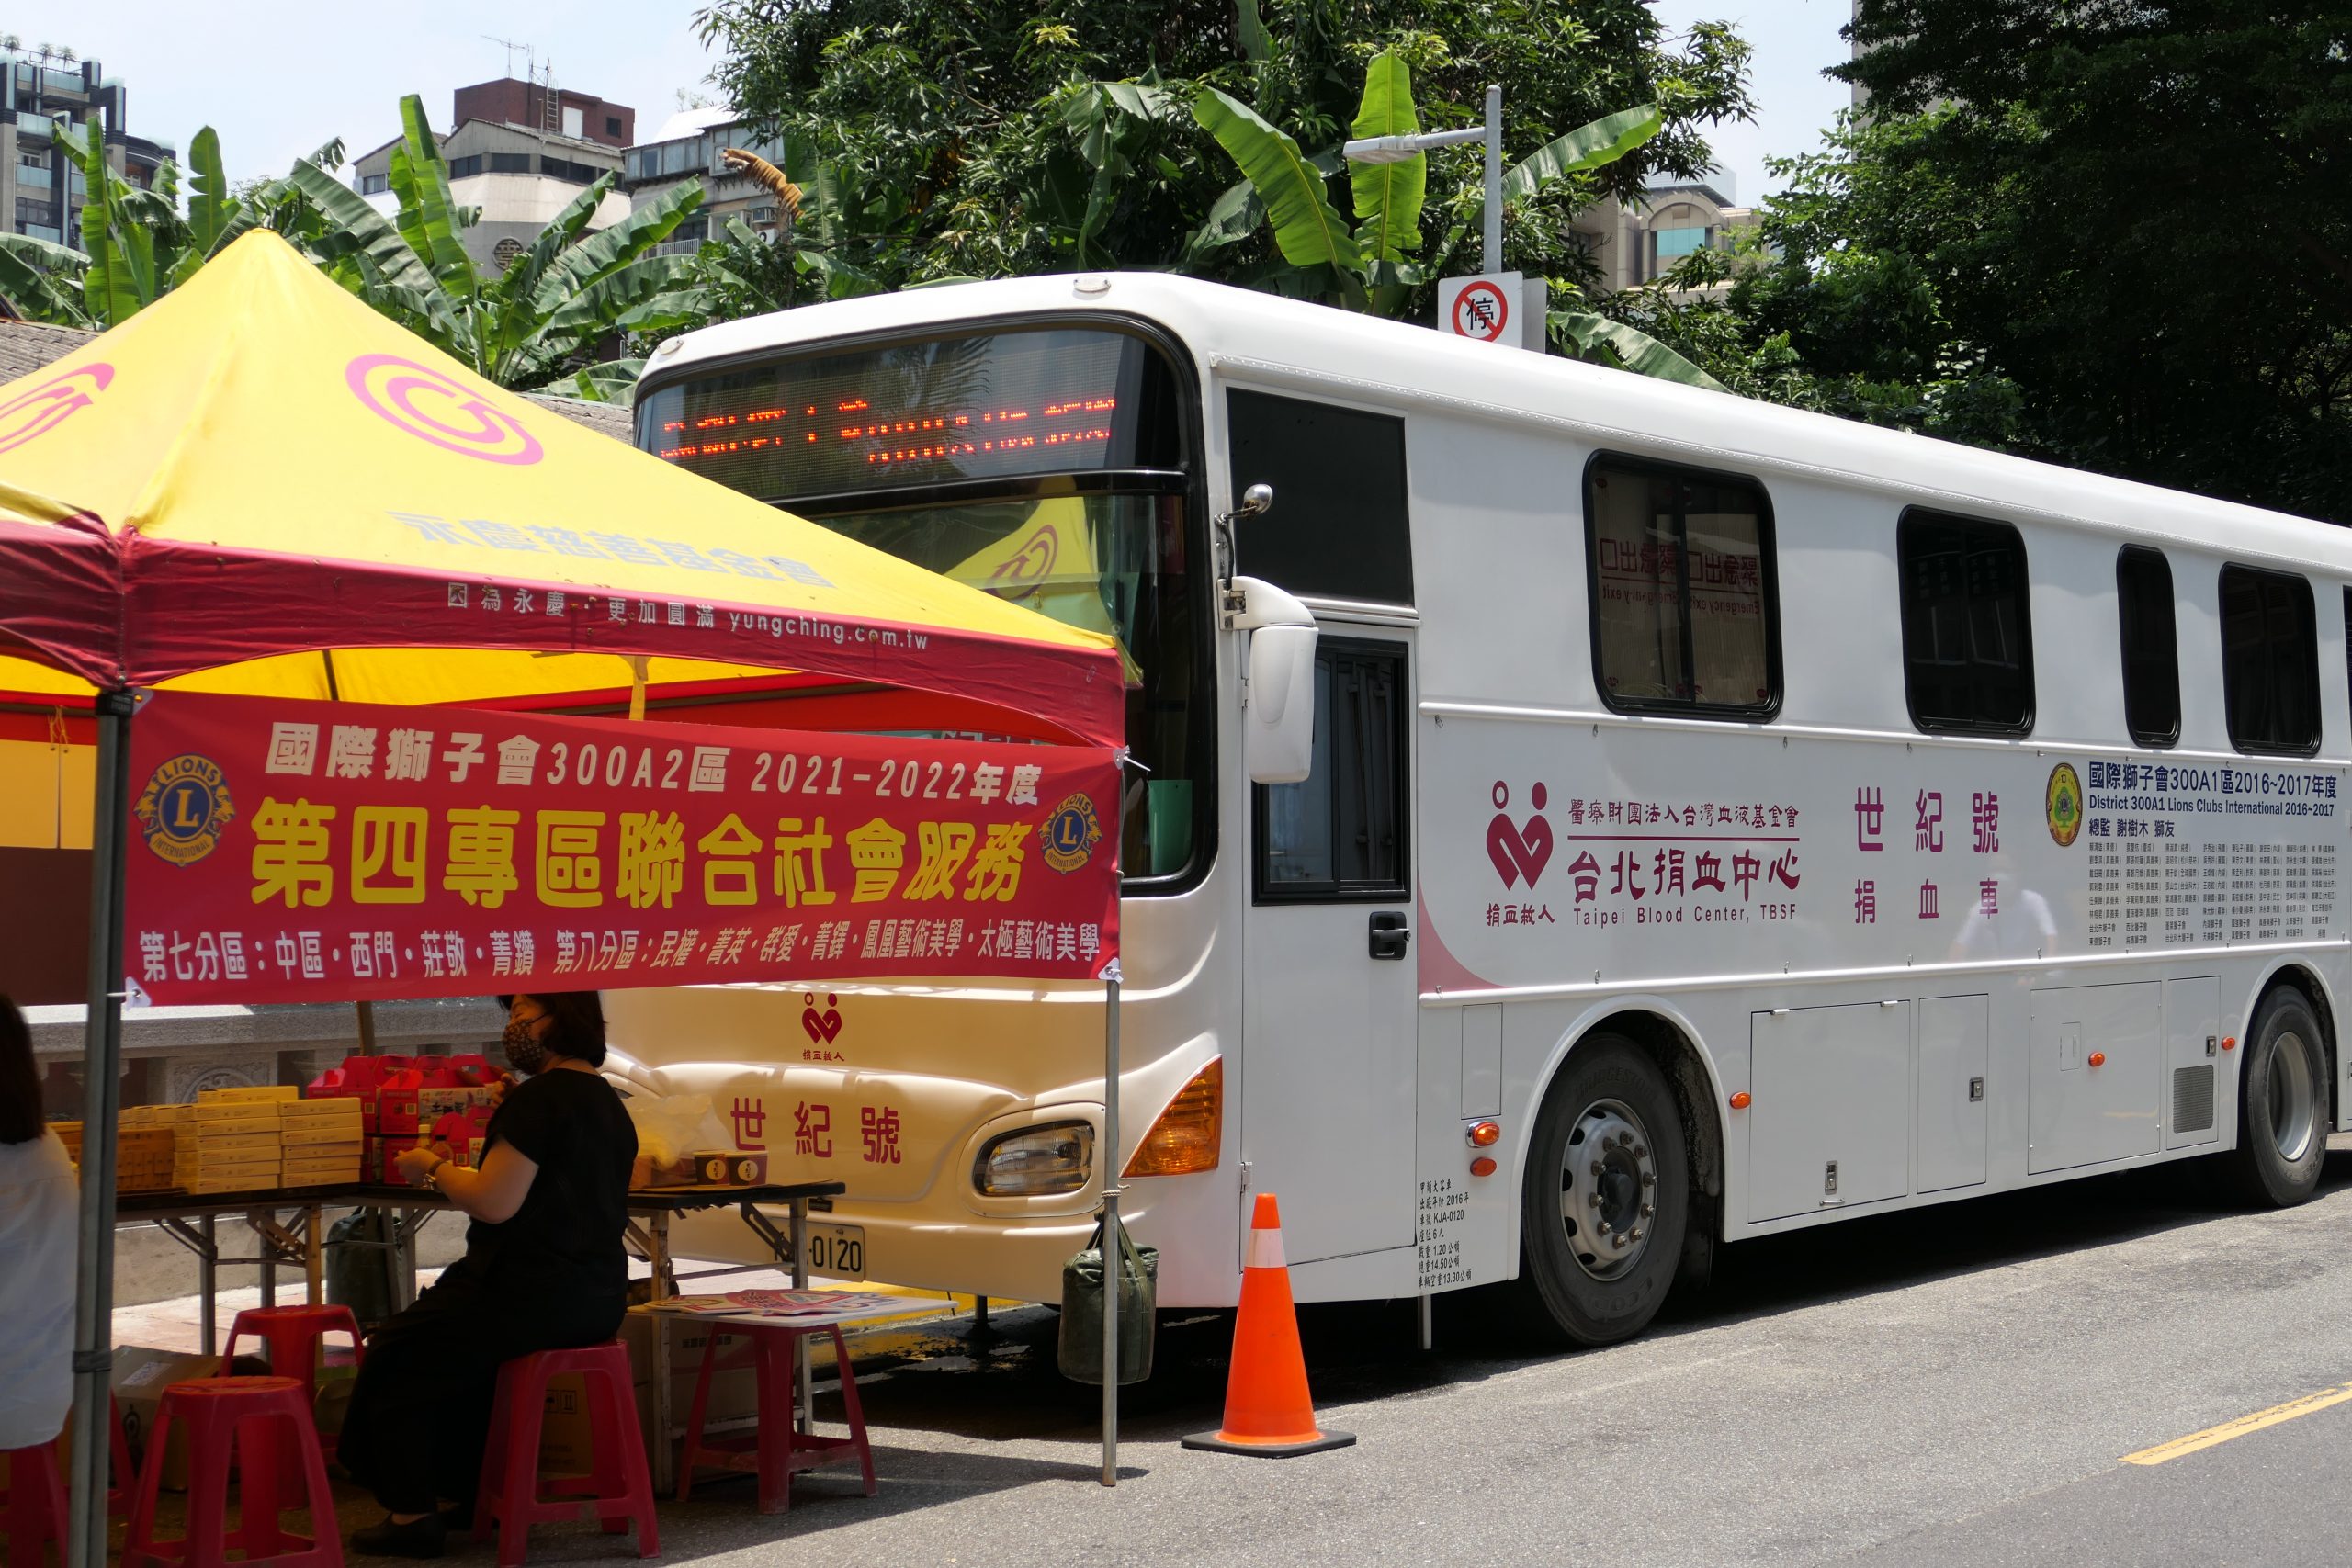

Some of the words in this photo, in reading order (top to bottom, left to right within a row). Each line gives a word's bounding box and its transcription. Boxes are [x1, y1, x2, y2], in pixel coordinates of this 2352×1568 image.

[1466, 297, 1494, 331] 停
[384, 510, 838, 589] 永慶慈善基金會
[729, 610, 928, 650] yungching.com.tw
[161, 758, 219, 783] LIONS
[265, 721, 731, 792] 國際獅子會300A2區
[750, 752, 1042, 806] 2021-2022年度
[2088, 761, 2337, 799] 國際獅子會300A1區2016~2017年度
[174, 789, 200, 828] L
[1059, 795, 1091, 812] LIONS
[1567, 799, 1800, 829] 醫療財團法人台灣血液基金會
[2089, 795, 2129, 810] District
[2132, 795, 2165, 811] 300A1
[2168, 797, 2194, 812] Lions
[2197, 798, 2222, 813] Clubs
[2225, 799, 2283, 816] International
[2285, 802, 2335, 817] 2016~2017
[1059, 816, 1077, 845] L
[1854, 786, 2001, 854] 世紀號
[2089, 818, 2110, 837] 總監
[2117, 818, 2149, 837] 謝樹木
[2154, 819, 2175, 837] 獅友
[153, 837, 211, 859] INTERNATIONAL
[251, 796, 1034, 909] 第四專區聯合社會服務
[1047, 852, 1086, 868] INTERNATIONAL
[1567, 847, 1801, 904] 台北捐血中心
[1486, 902, 1555, 927] 捐血救人
[1573, 908, 1625, 929] Taipei
[1637, 906, 1683, 924] Blood
[1694, 905, 1749, 924] Center,
[1760, 903, 1796, 920] TBSF
[1854, 878, 2001, 924] 捐血車
[730, 1097, 901, 1164] 世紀號
[1433, 1210, 1464, 1224] KJA-0120
